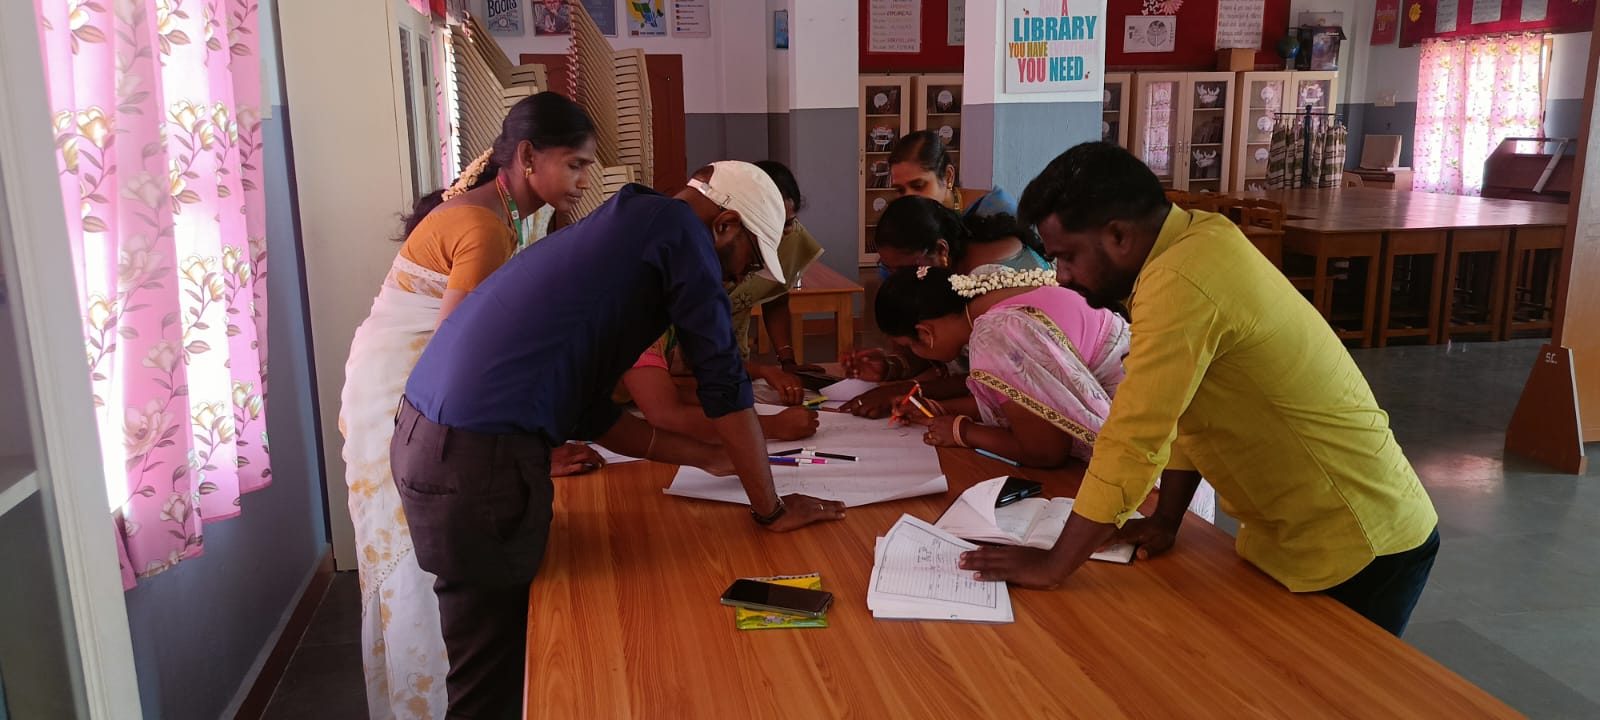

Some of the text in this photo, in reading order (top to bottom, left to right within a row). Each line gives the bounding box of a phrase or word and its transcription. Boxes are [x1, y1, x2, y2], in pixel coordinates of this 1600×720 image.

[1013, 15, 1098, 42] LIBRARY
[1009, 42, 1026, 58] YOU
[1027, 41, 1048, 57] HAVE
[1017, 58, 1047, 83] YOU
